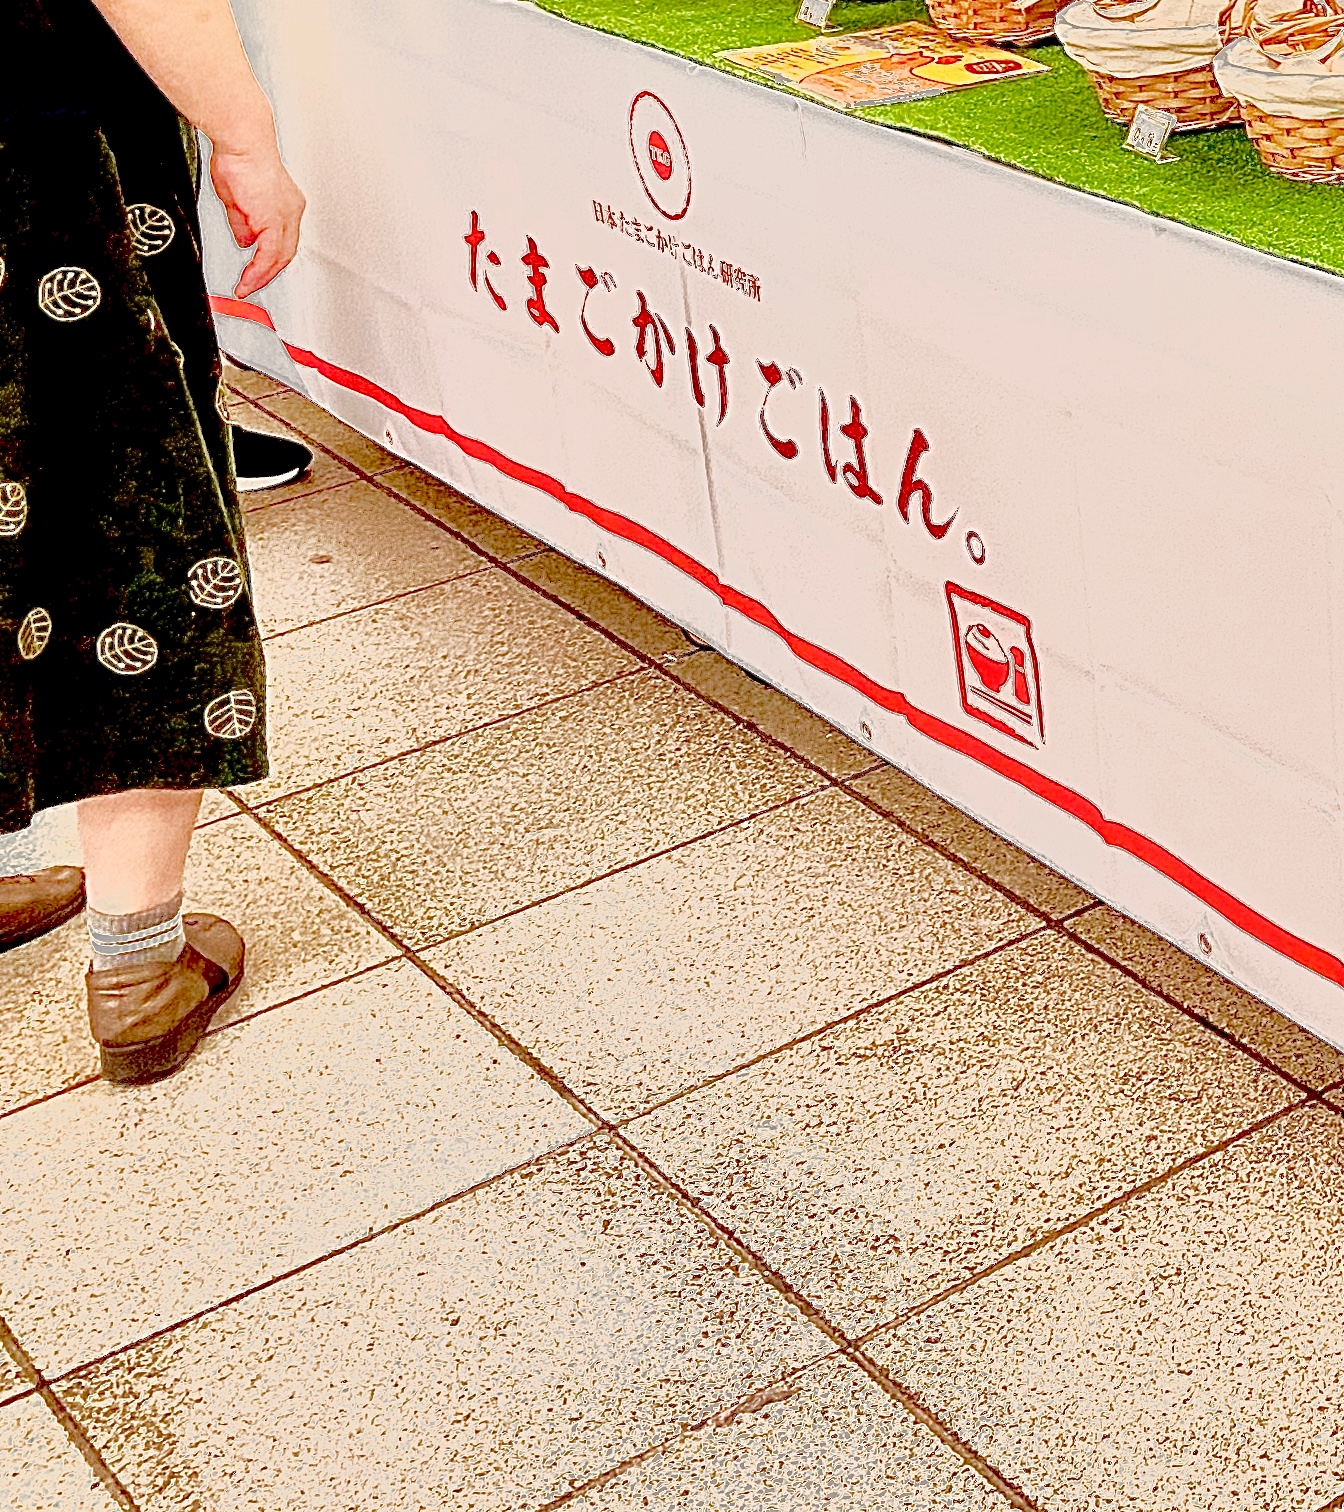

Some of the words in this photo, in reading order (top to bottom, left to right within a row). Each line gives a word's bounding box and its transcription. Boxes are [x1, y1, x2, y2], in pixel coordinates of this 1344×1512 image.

[649, 144, 672, 167] TKG
[592, 199, 762, 303] 日本たまごかけごはん研究所
[463, 209, 987, 565] たまごかけごはん。
